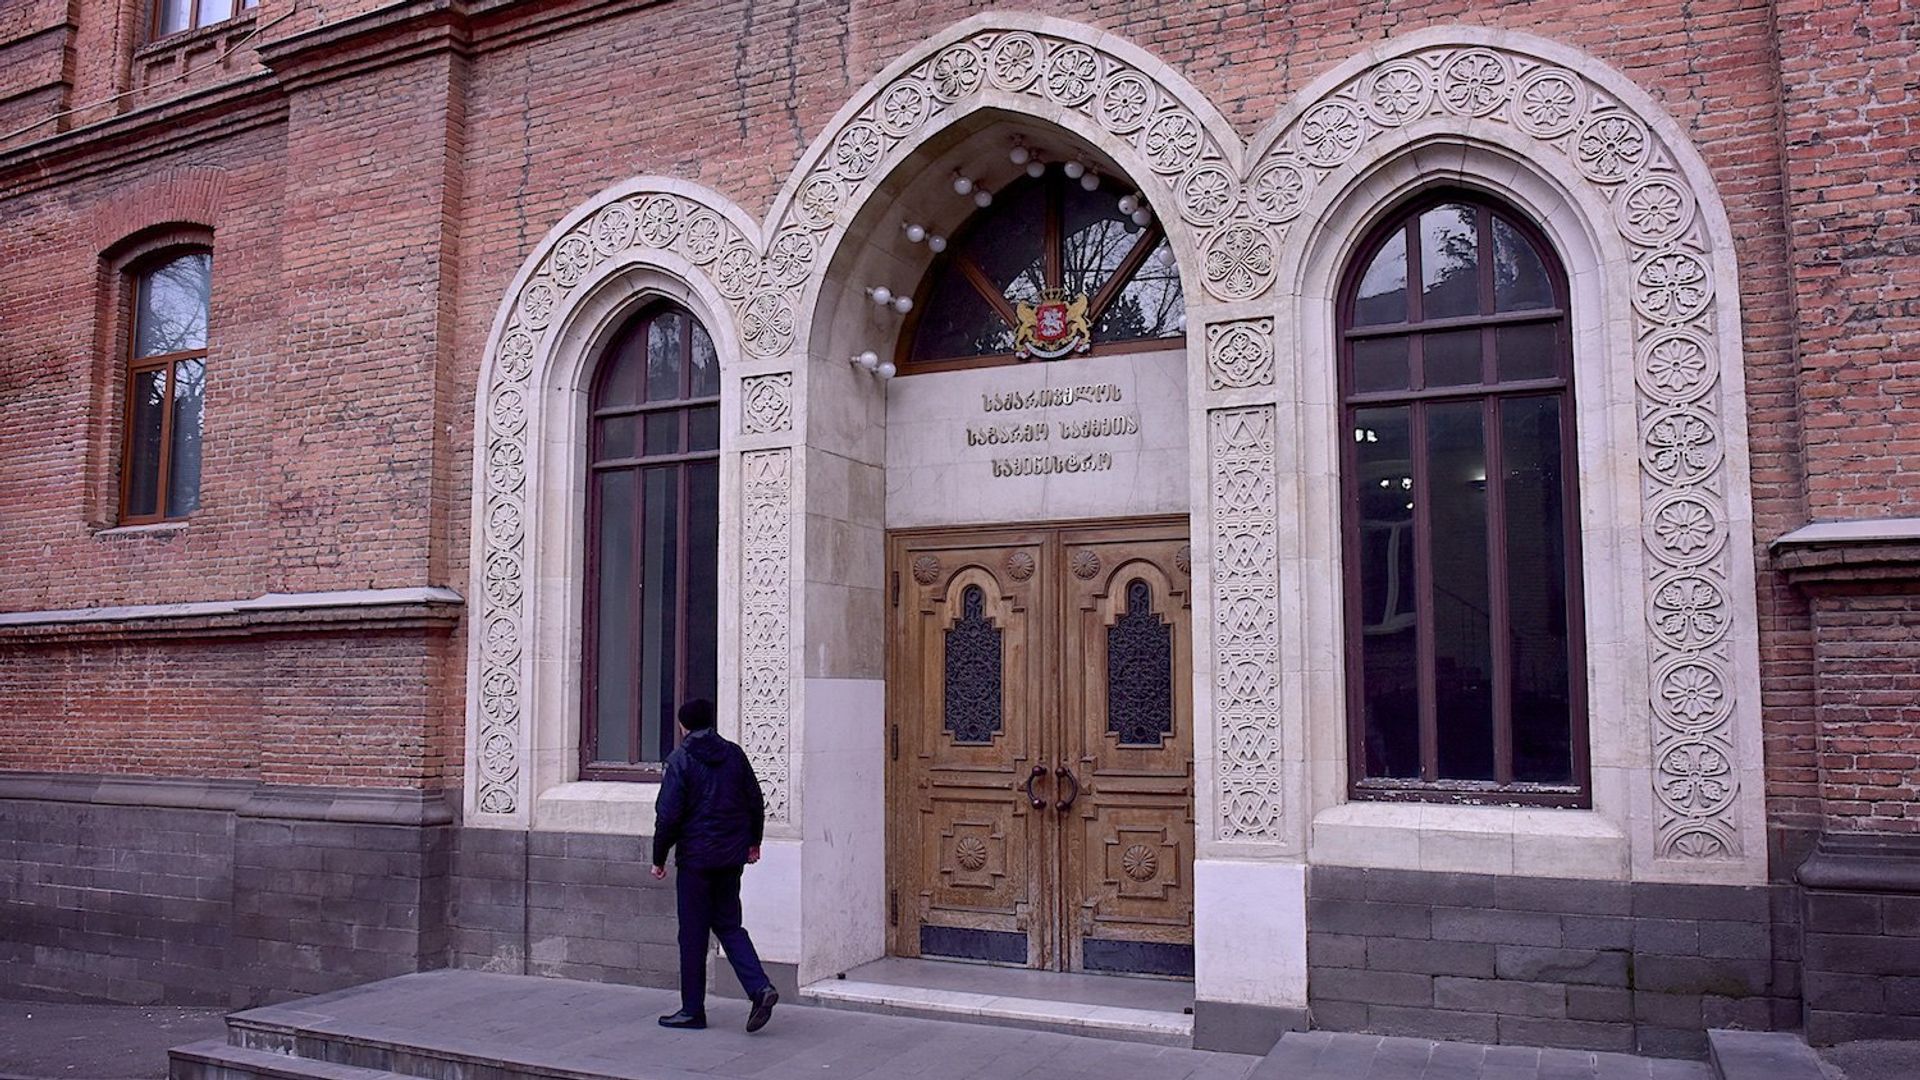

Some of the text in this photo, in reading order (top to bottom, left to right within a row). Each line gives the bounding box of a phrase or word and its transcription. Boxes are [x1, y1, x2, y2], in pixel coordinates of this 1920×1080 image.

[966, 414, 1138, 446] საგარეო საქმეთა
[991, 451, 1113, 477] სამინისტრო
